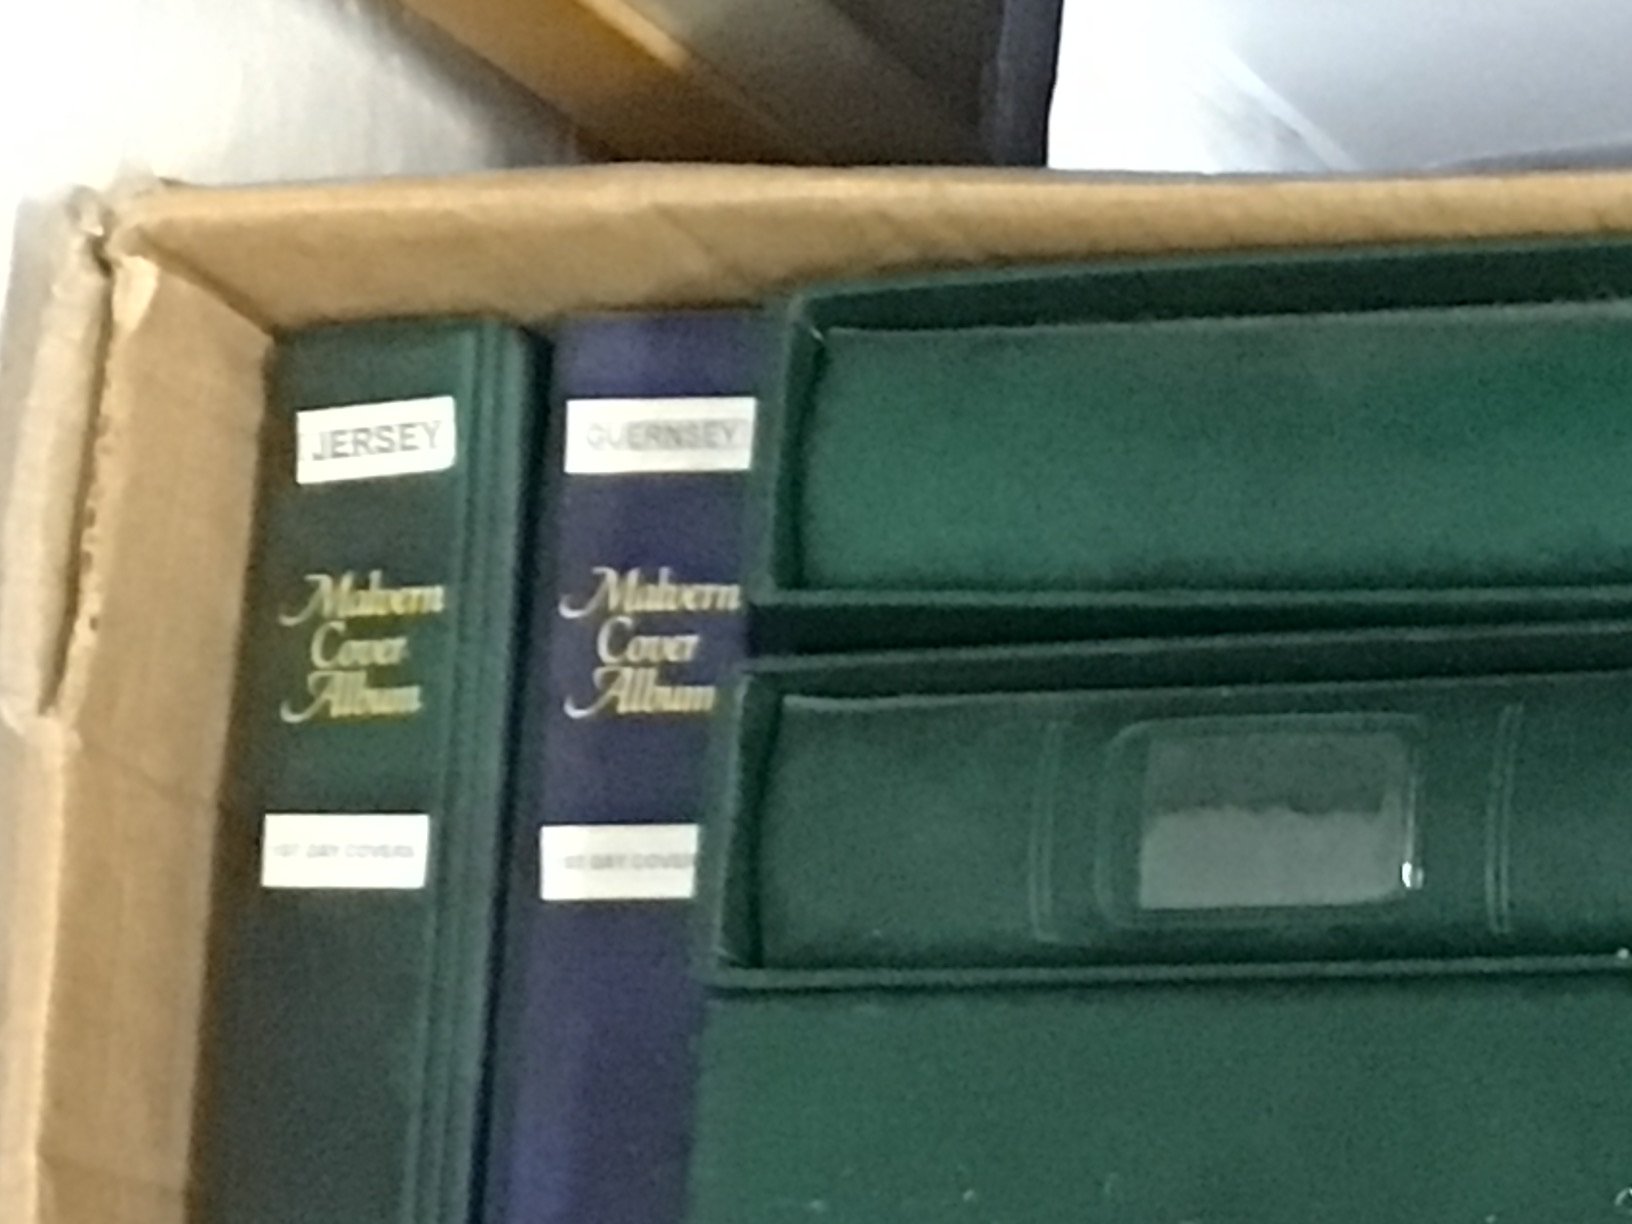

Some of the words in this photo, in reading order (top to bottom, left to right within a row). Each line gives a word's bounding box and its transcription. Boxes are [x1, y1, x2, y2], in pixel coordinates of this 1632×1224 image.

[312, 420, 442, 460] JERSEY
[587, 420, 738, 450] GUERNSEY
[280, 569, 446, 627] Malvern
[559, 567, 741, 620] Malvern
[311, 622, 407, 667] Cover
[597, 617, 699, 666] Cover
[281, 669, 423, 725] Album
[565, 666, 718, 720] Album
